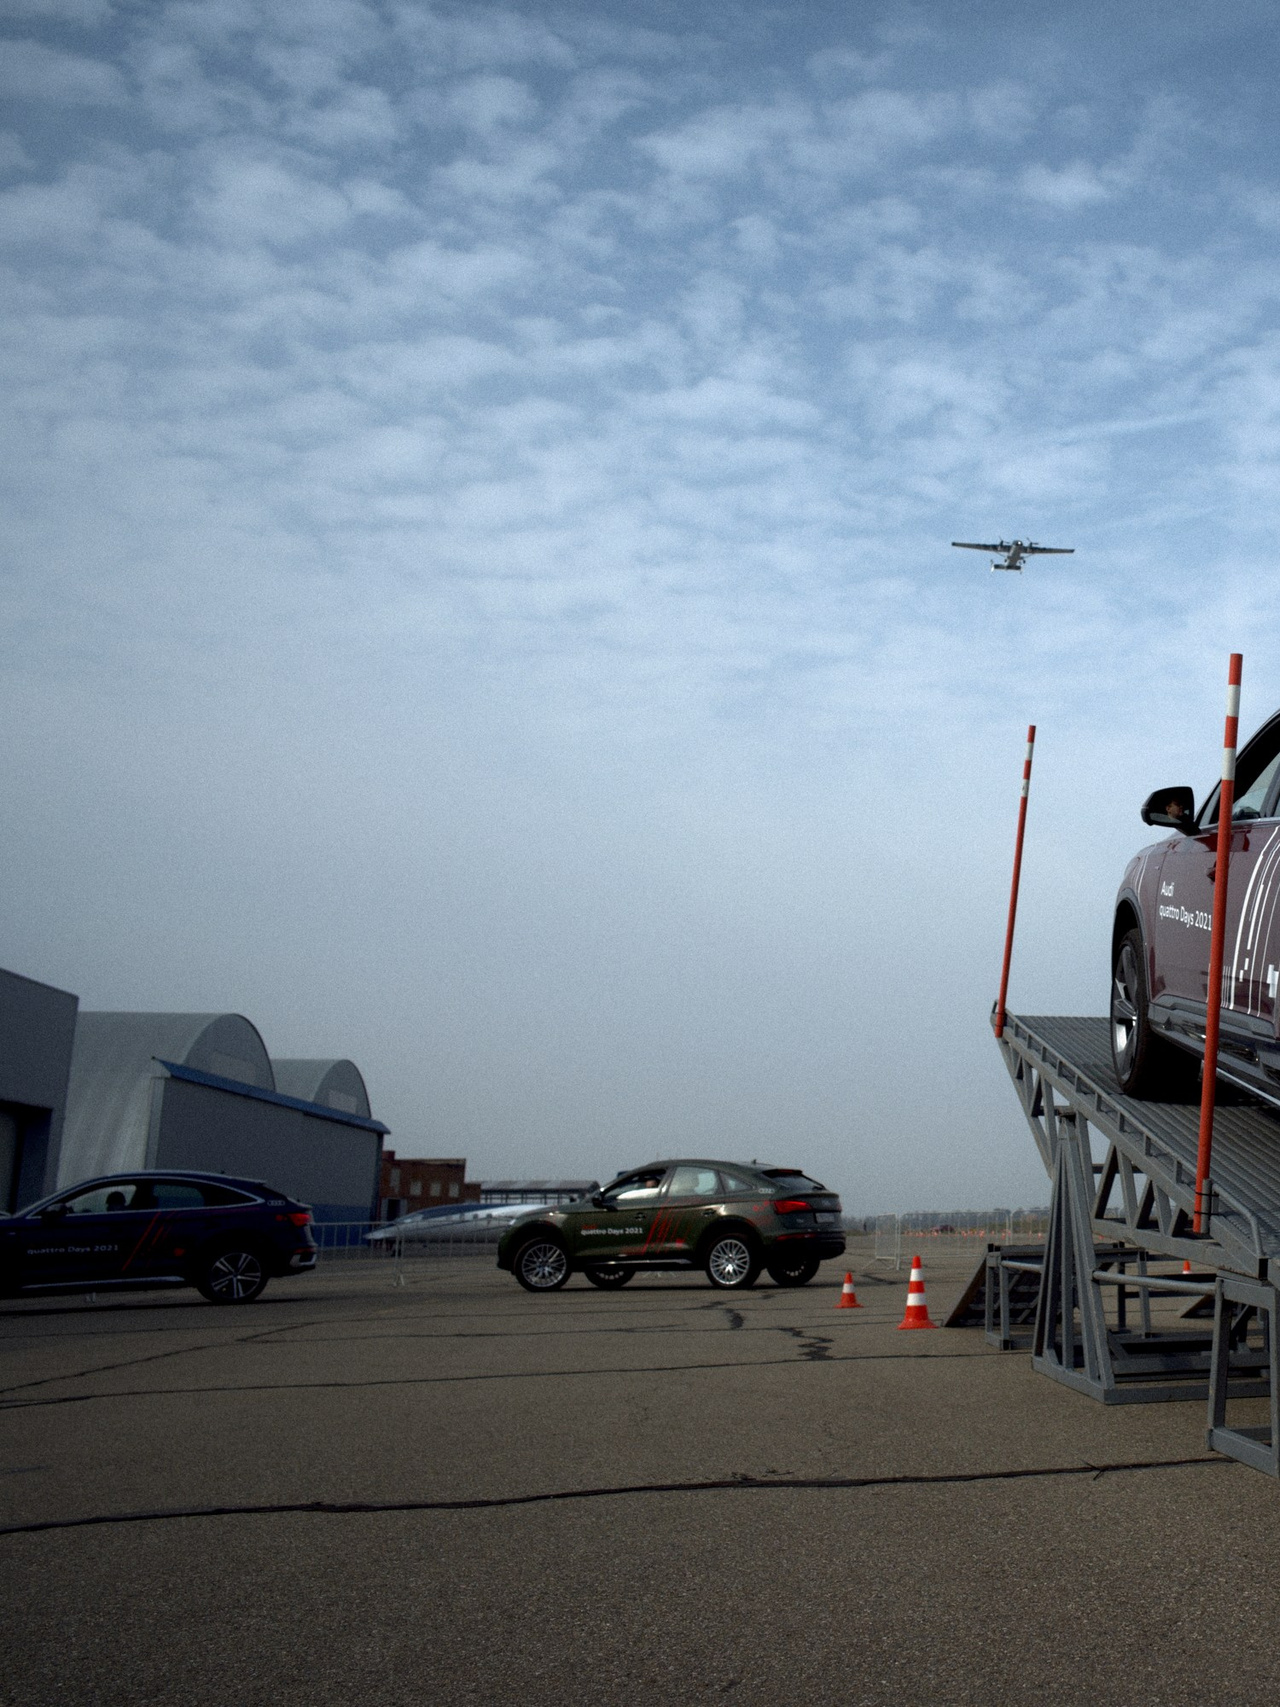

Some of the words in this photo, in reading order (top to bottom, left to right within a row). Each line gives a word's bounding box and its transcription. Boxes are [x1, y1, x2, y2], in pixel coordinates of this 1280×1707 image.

[1160, 881, 1175, 897] Audi
[1159, 905, 1180, 920] quattro
[1180, 906, 1194, 928] Days
[1195, 910, 1212, 931] 2021
[93, 1244, 119, 1252] 2021
